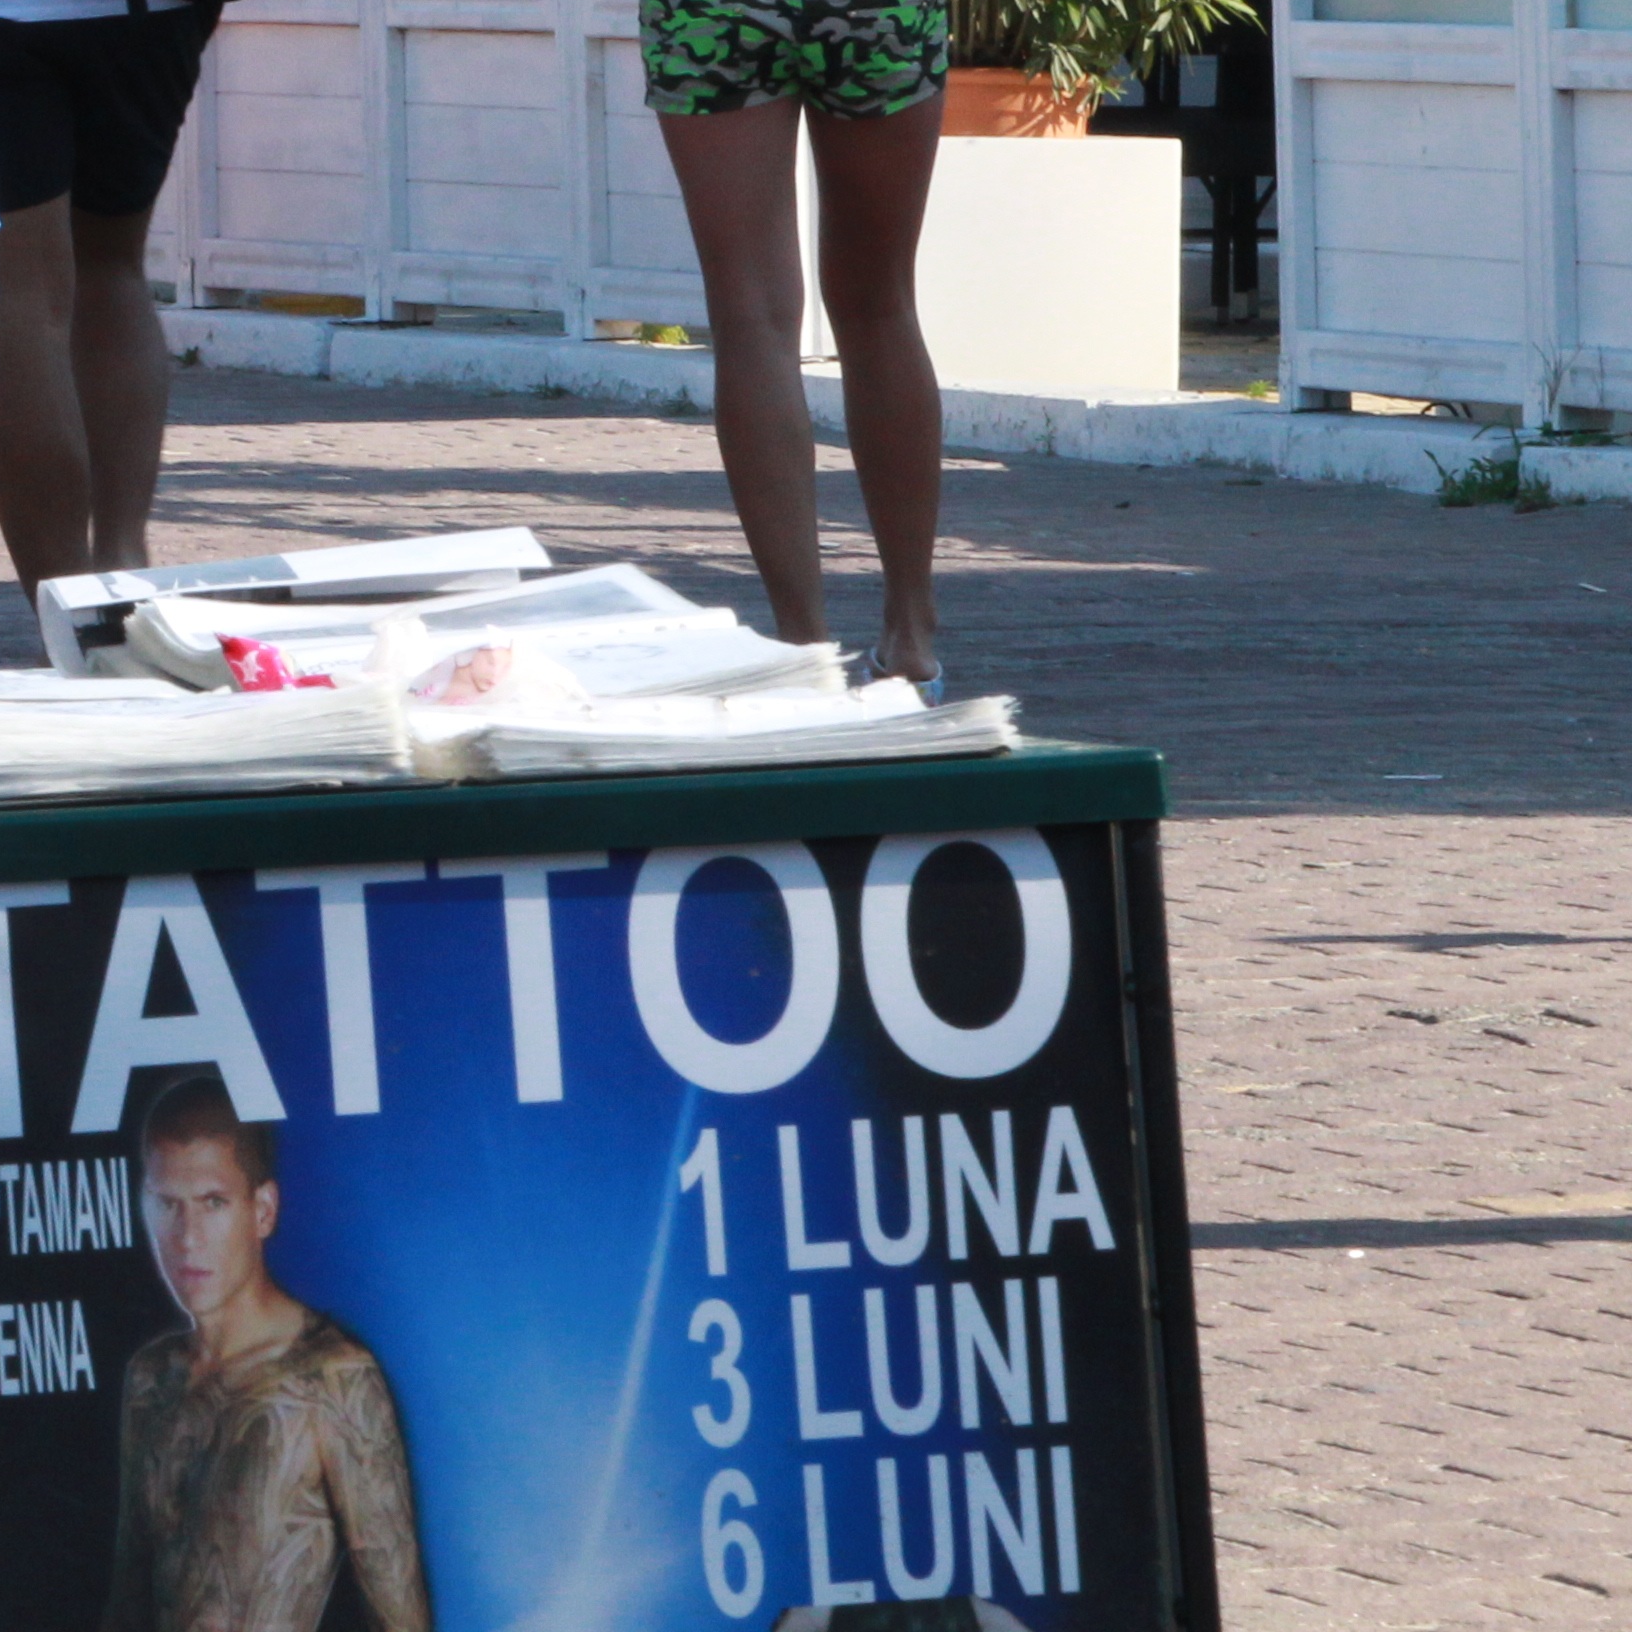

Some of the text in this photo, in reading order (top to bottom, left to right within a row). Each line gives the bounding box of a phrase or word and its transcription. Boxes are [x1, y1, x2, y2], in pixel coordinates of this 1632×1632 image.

[679, 1105, 1116, 1276] 1 LUNA
[688, 1276, 1068, 1448] 3 LUNI
[701, 1445, 1080, 1620] 6 LUNI
